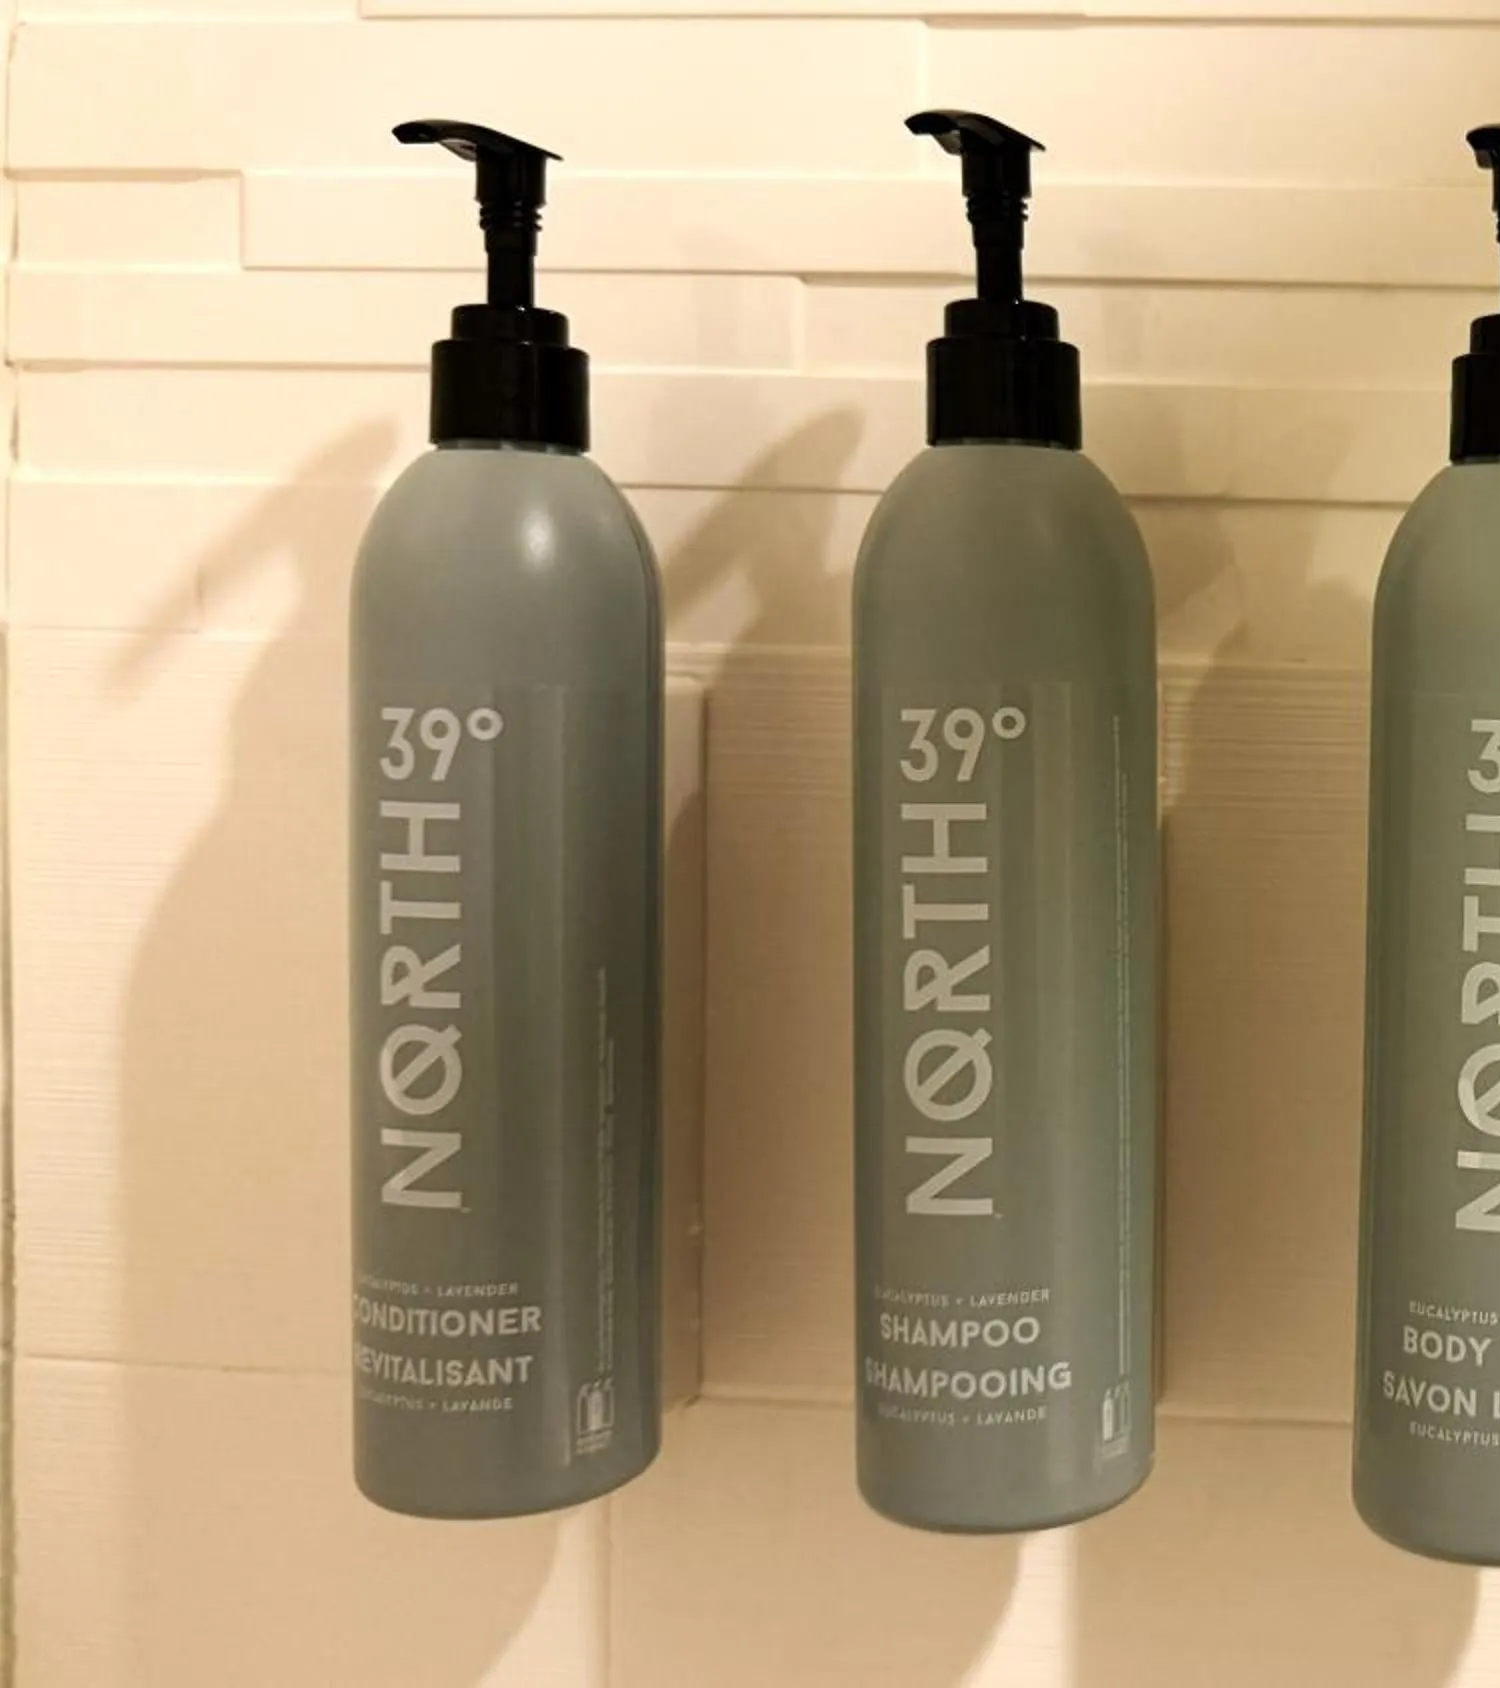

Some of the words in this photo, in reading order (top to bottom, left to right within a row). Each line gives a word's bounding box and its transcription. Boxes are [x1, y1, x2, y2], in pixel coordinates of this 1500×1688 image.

[380, 708, 503, 781] 39°
[900, 707, 1026, 782] 39°
[437, 1282, 519, 1298] LAVENDER
[970, 1288, 1050, 1308] LAVENDER
[880, 1312, 1041, 1348] SHAMPOO
[1409, 1300, 1498, 1326] EUCALYPTUS
[353, 1342, 534, 1387] EVITALISANT
[1403, 1325, 1492, 1368] BODY
[864, 1356, 1073, 1400] SHAMPOOING
[1382, 1369, 1477, 1418] SAVON
[442, 1398, 514, 1413] LAVANDE
[976, 1405, 1049, 1426] LAVANDE
[1409, 1421, 1499, 1447] EUCALYPTUS
